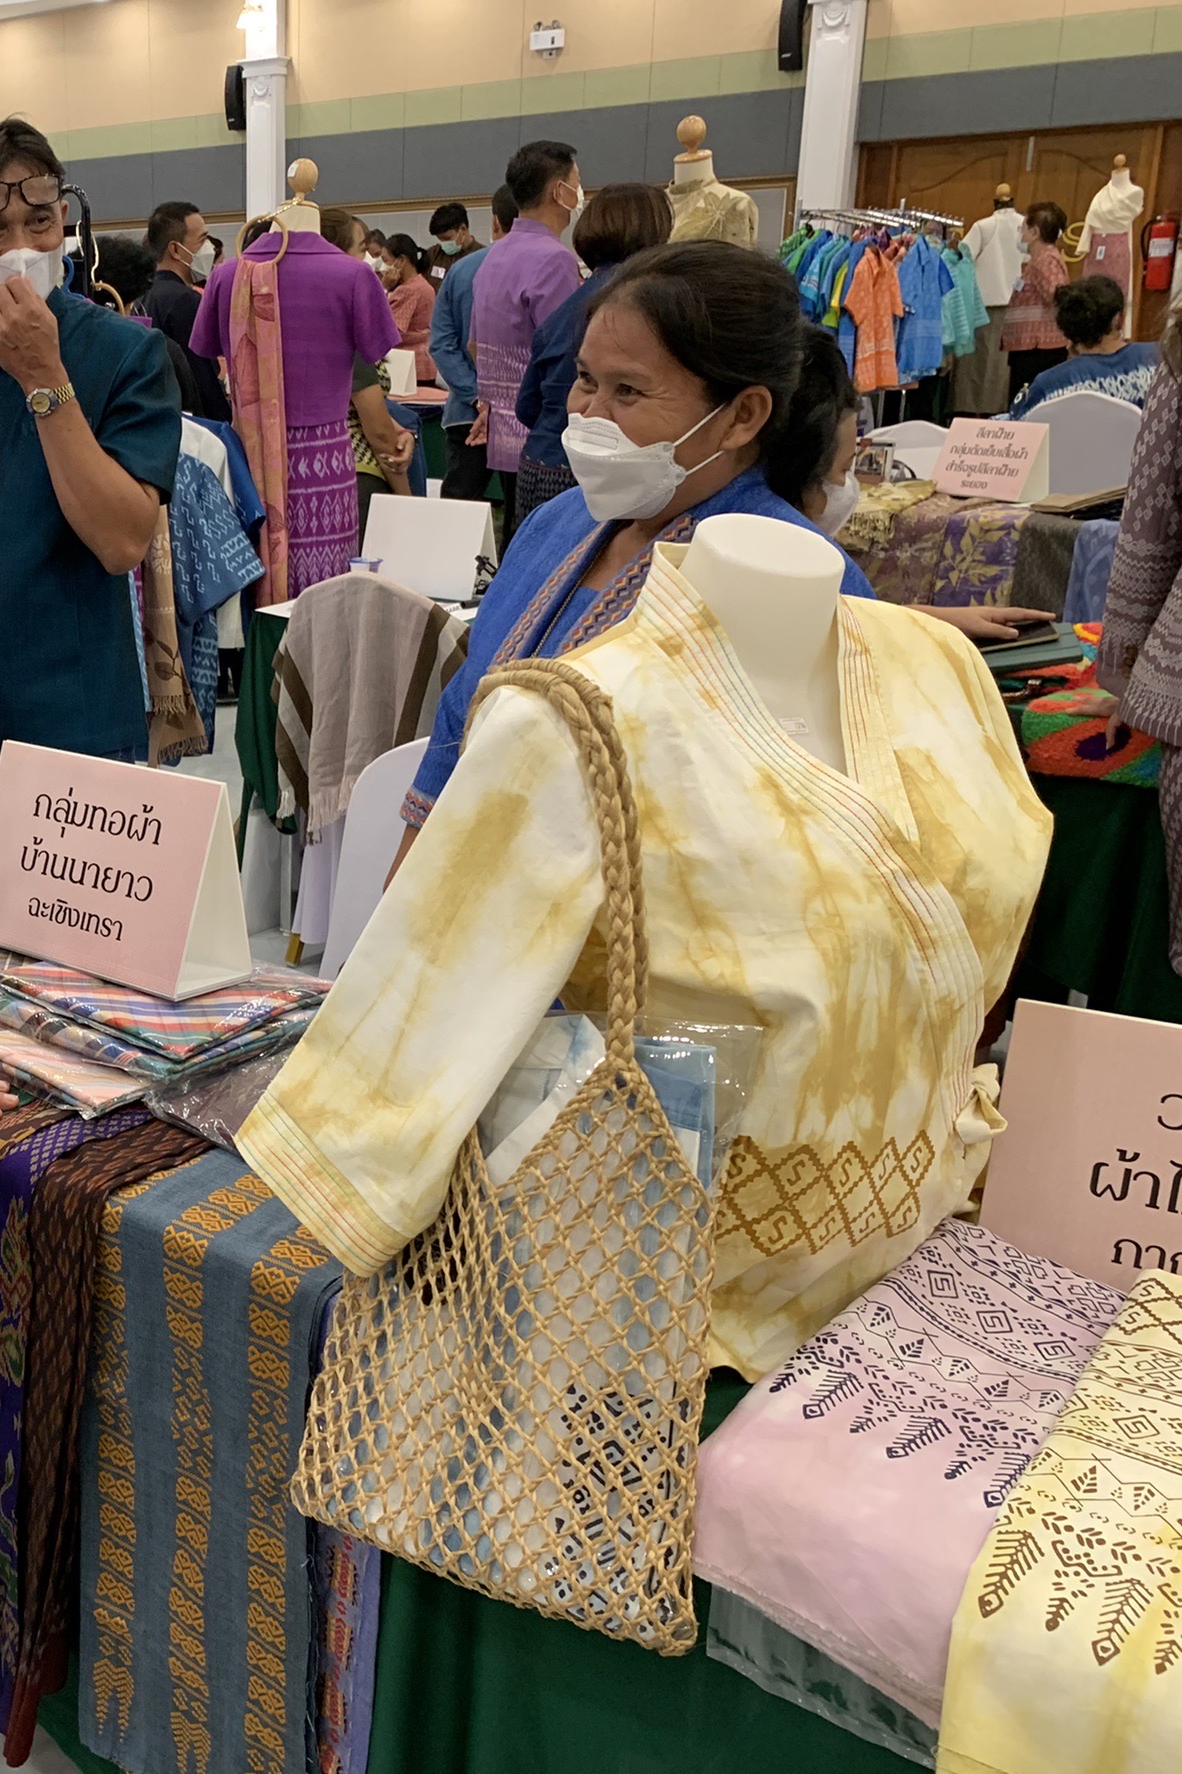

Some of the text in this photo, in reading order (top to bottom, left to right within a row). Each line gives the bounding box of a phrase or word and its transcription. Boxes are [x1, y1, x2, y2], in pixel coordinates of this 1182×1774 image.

[960, 479, 989, 490] ระยอง
[32, 787, 162, 845] กลุ่มทอผ้า
[20, 836, 154, 901] บ้านนายาว
[28, 897, 124, 941] ฉะเชิงเทรา
